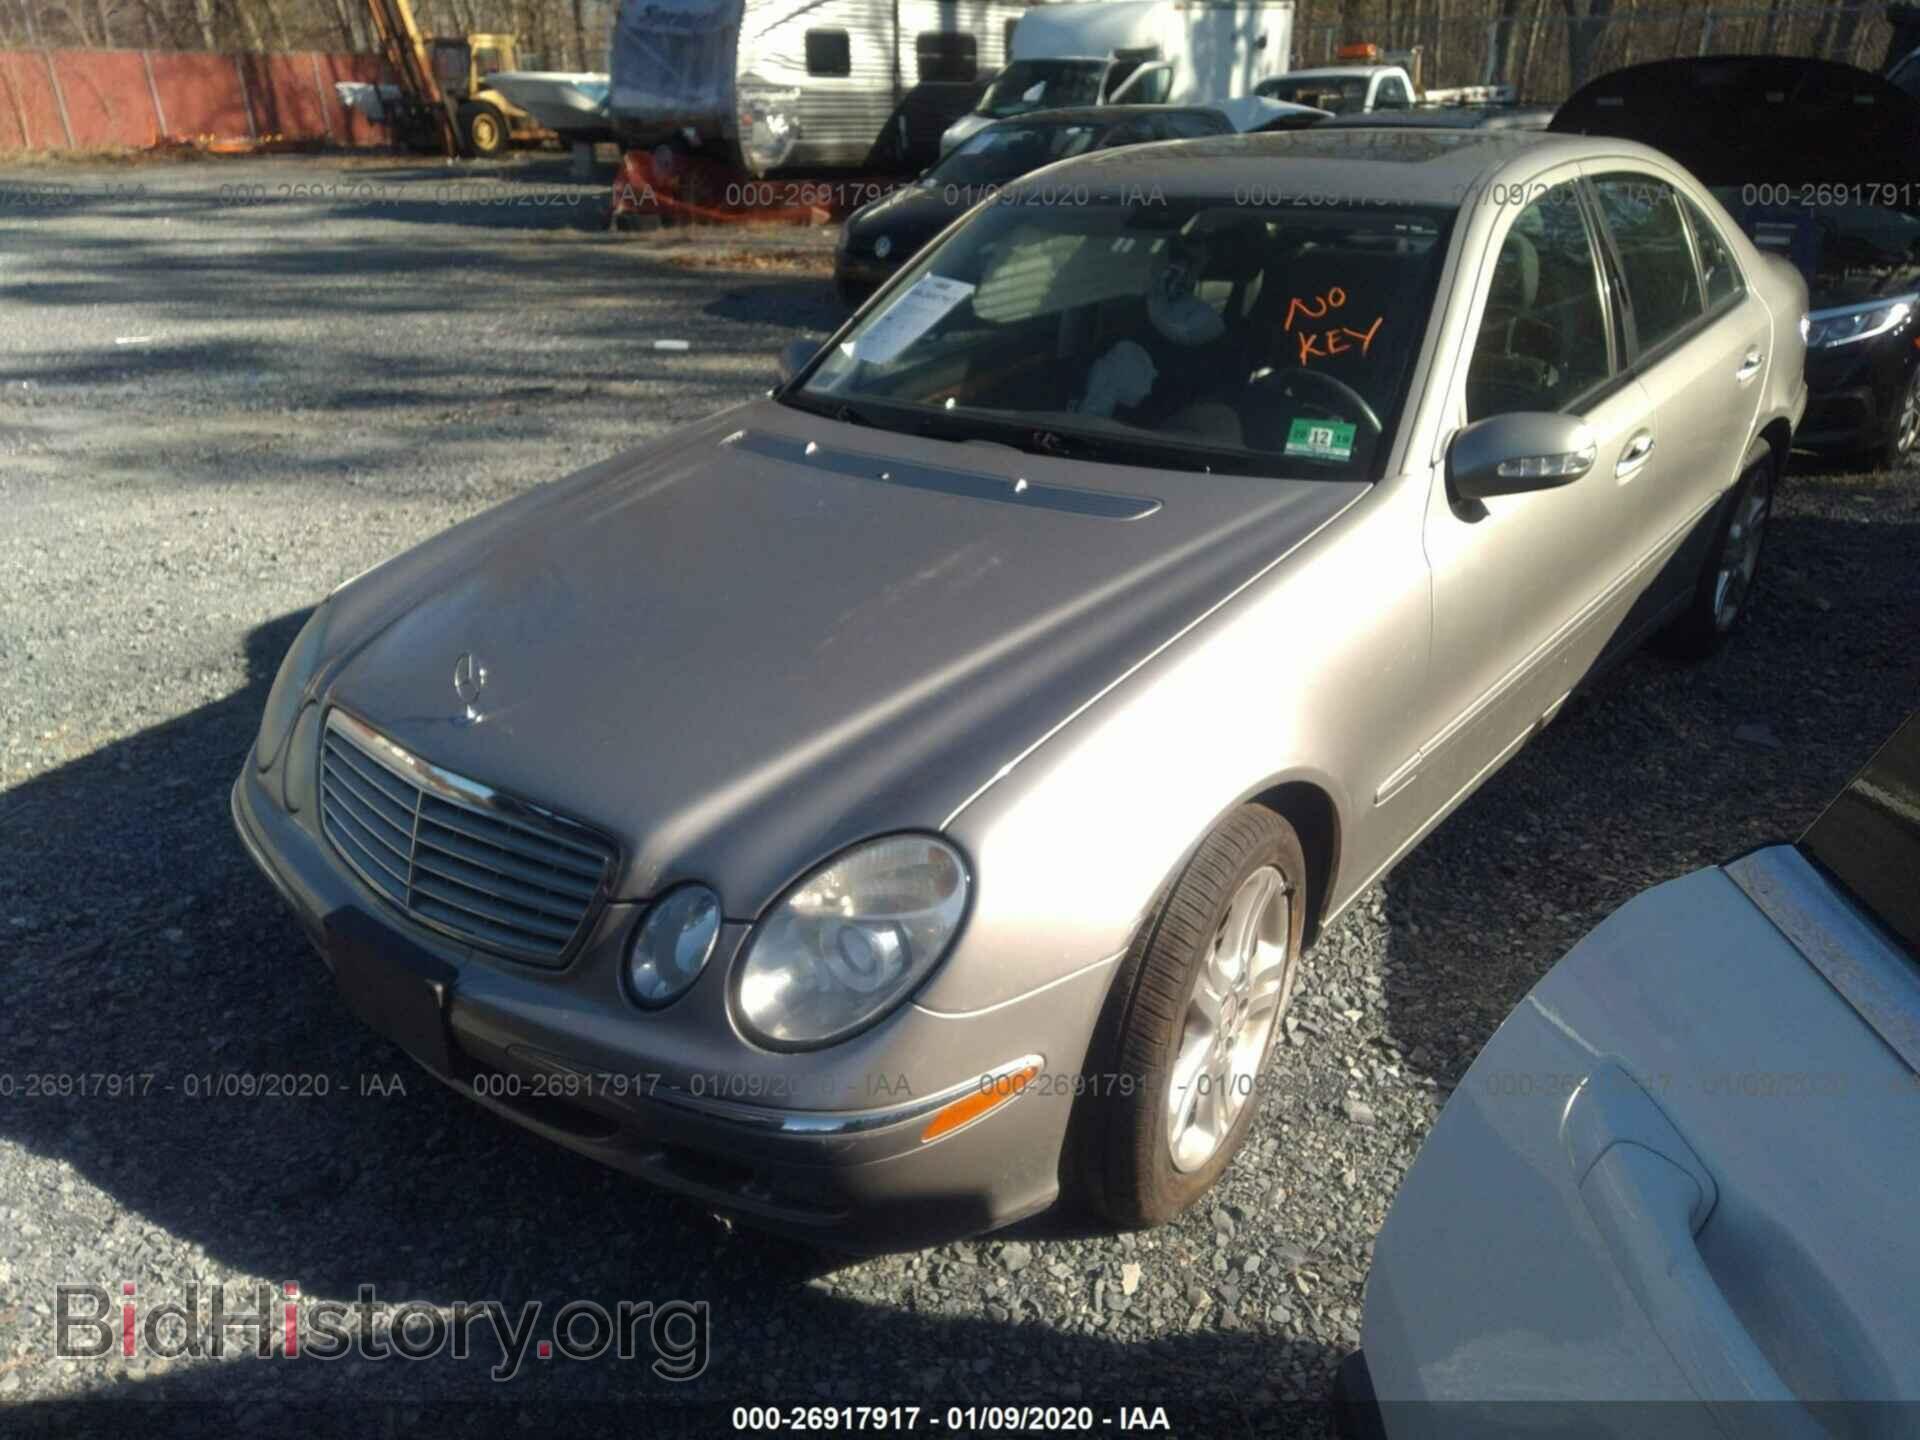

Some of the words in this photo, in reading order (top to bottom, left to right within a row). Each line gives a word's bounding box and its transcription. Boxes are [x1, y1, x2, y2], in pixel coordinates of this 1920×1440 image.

[1284, 287, 1346, 332] NO
[1298, 316, 1384, 367] KEY
[1311, 430, 1329, 445] 12
